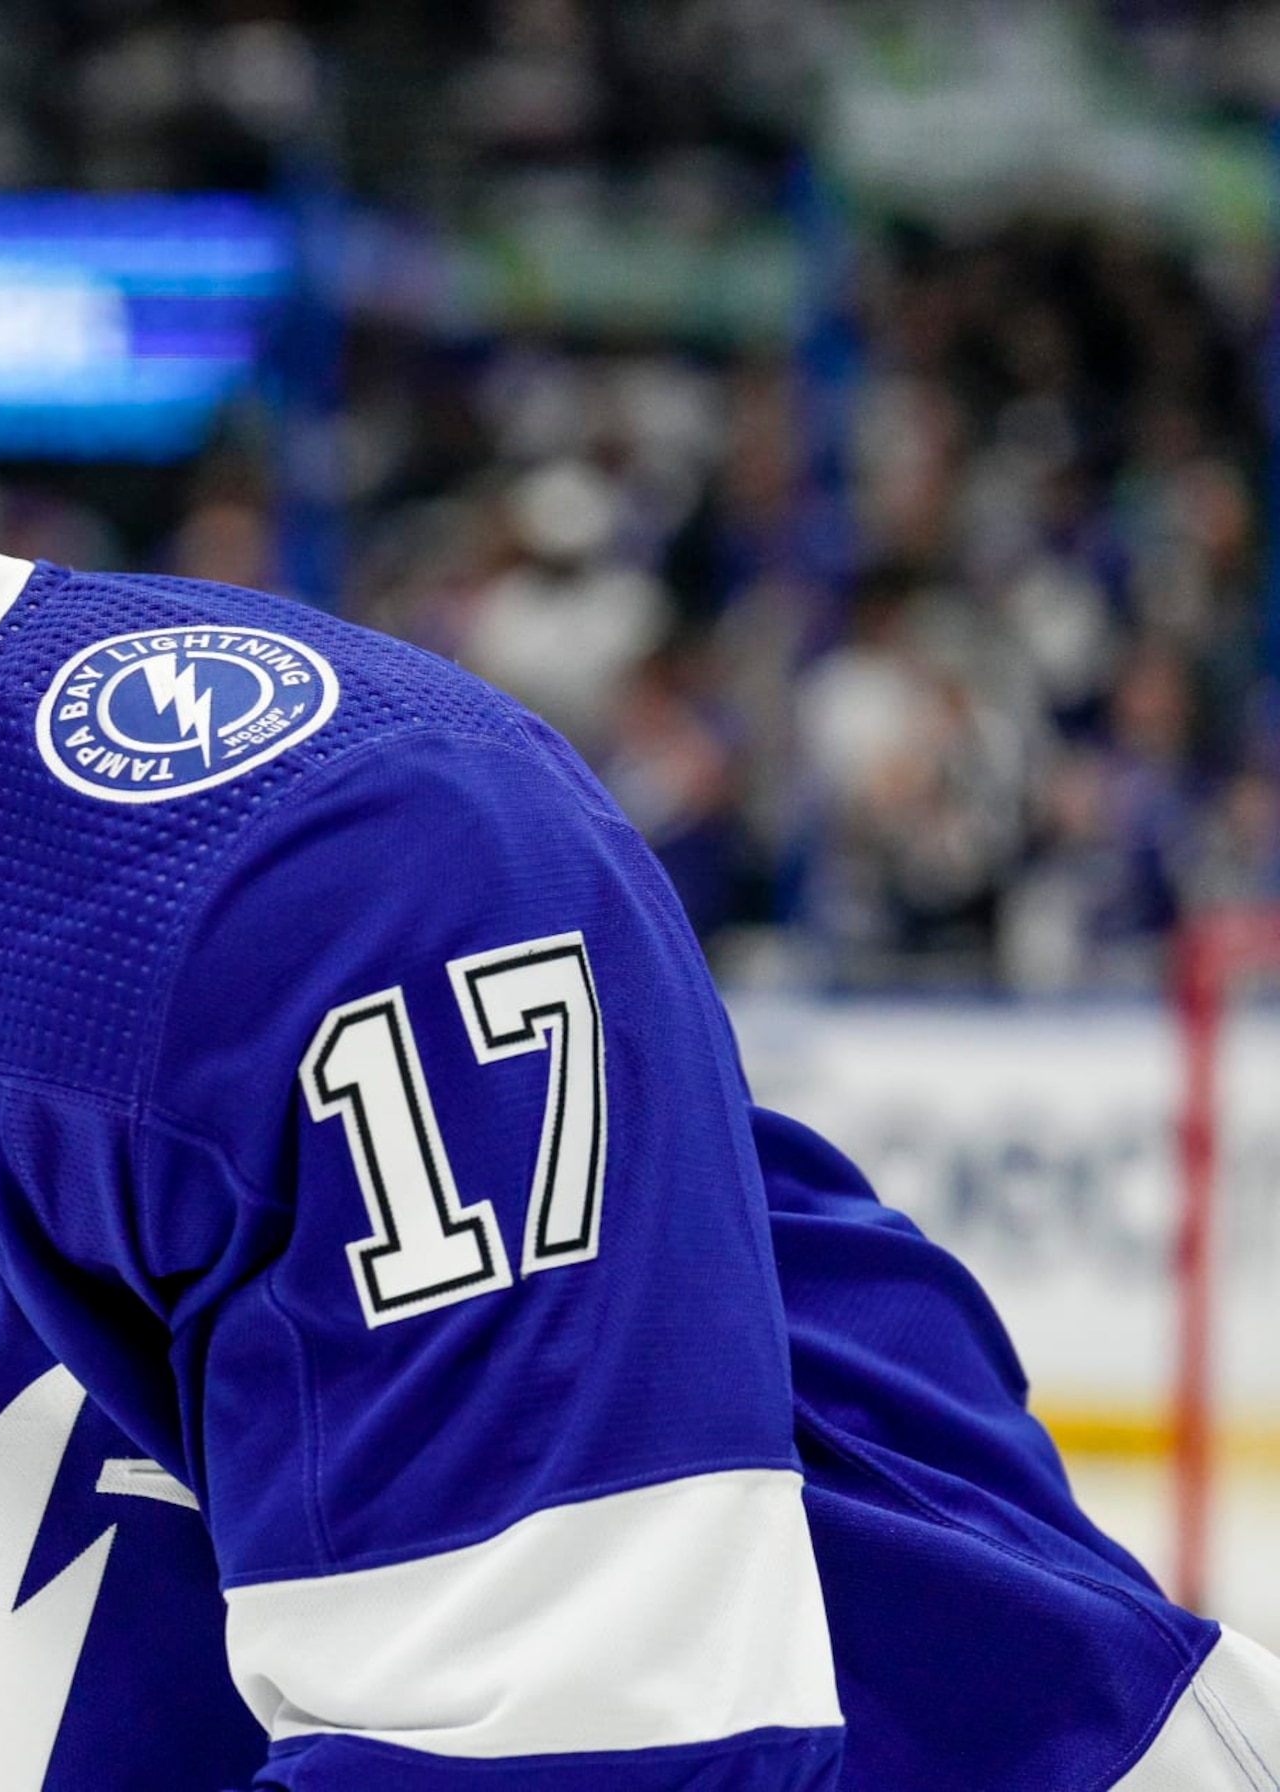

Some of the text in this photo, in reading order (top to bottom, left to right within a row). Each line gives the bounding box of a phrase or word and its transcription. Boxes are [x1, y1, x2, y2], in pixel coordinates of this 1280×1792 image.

[59, 634, 311, 781] TAMPA BAY LIGHTNING
[223, 708, 284, 747] HOCKEY
[250, 719, 291, 744] CLUB
[298, 931, 607, 1329] 17
